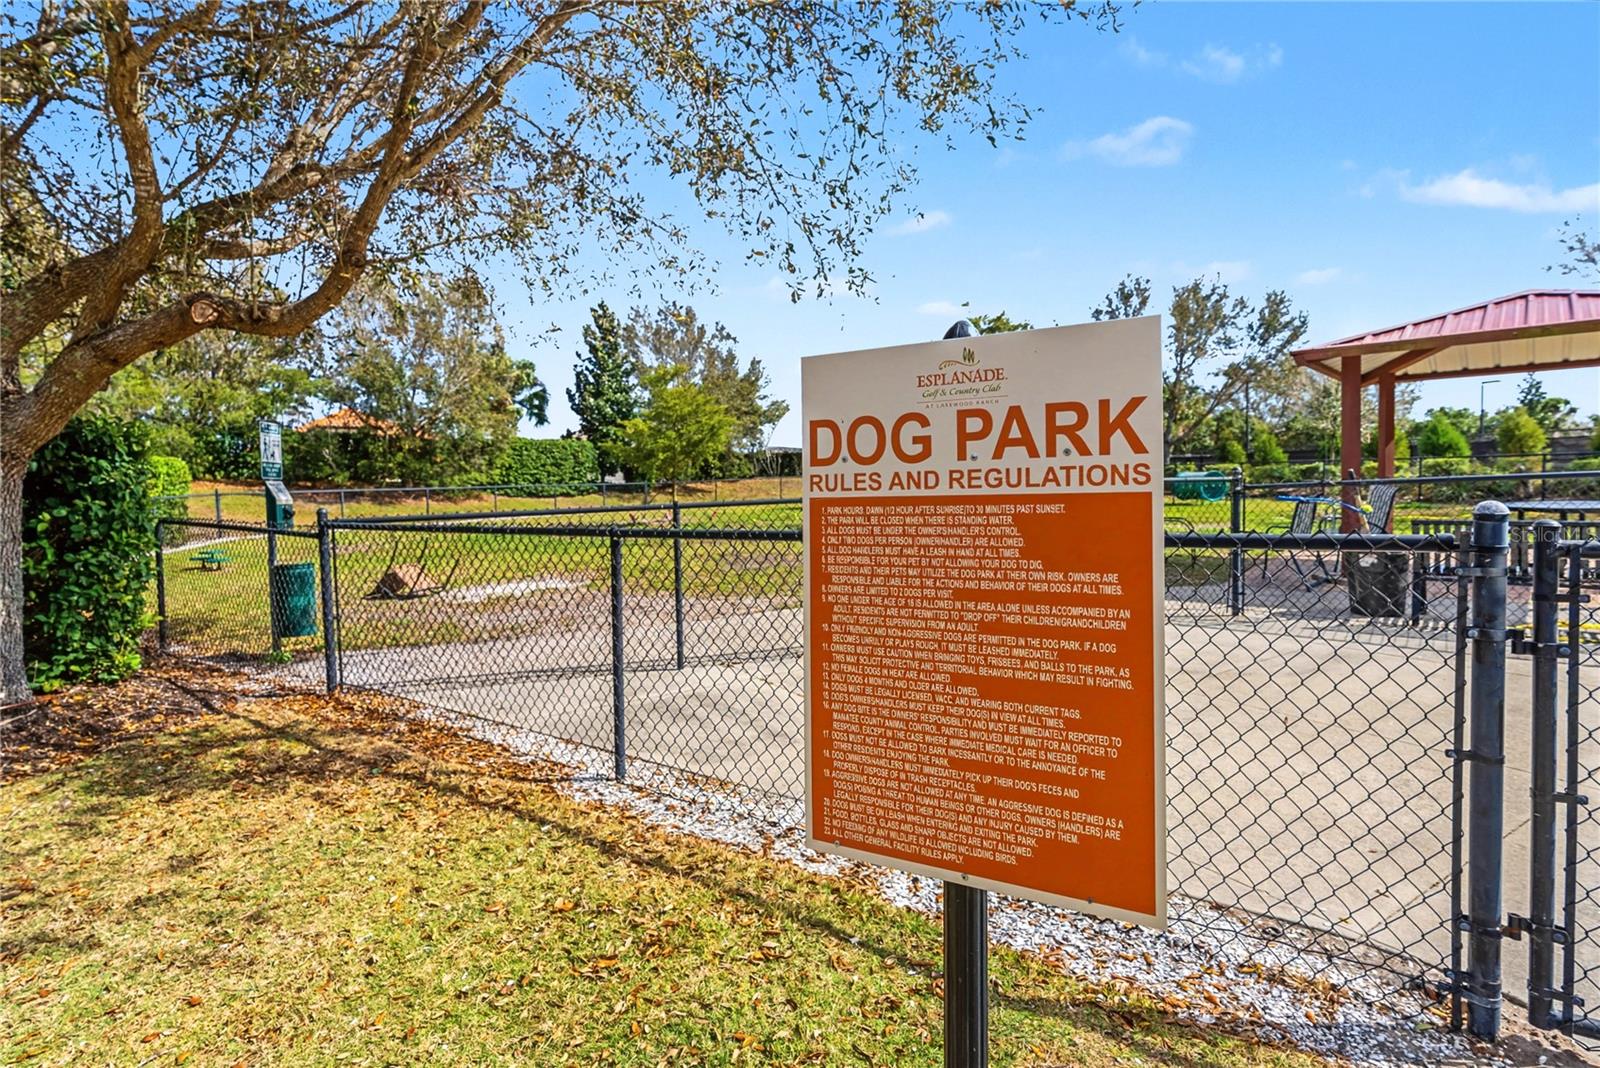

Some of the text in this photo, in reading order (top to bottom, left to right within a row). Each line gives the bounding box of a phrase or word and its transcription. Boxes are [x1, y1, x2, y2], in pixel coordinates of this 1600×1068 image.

[922, 389, 938, 399] Golf
[949, 386, 980, 396] Country
[982, 383, 1002, 393] Club
[809, 395, 1150, 468] DOG PARK
[809, 463, 1152, 492] RULES AND REGULATIONS
[914, 504, 1065, 513] AFTER MINUTES PAST SUNSET.
[904, 516, 1013, 524] WHEN THERE STANDING WATER.
[902, 547, 1020, 557] HAVE LEASH HAND ALL TIMES.
[974, 537, 1024, 546] ARE ALLOWED.
[945, 558, 1043, 569] ALLOWING YOUR DOG DIG.
[922, 568, 1117, 583] UTILIZE DOG PARK THEIR OWN OWNERS ARE
[904, 588, 921, 596] DOGS
[935, 579, 1122, 595] ACTIONS AND BEHAVIOR THEIR DOGS ALL TIMES.
[922, 599, 1105, 617] ALLOWED THE AREA ALONE UNLESS ACCOMPANIED
[1001, 614, 1022, 623] THEIR
[926, 620, 978, 631] FROM ADULT.
[943, 632, 962, 641] DOGS
[963, 633, 976, 642] ARE
[978, 634, 1016, 645] PERMITTED
[1026, 638, 1040, 647] THE
[1042, 639, 1058, 648] DOG
[1099, 643, 1115, 653] DOG
[948, 642, 1058, 660] MUST LEASHED IMMEDIATELY.
[914, 650, 1093, 674] WHEN BRINGING AND BALLS THE
[935, 662, 1131, 689] TERRITORIAL BEHAVIOR WHICH MAY RESULT FIGHTING.
[908, 680, 979, 696] OLDER ALLOWED.
[908, 701, 1064, 728] MUST KEEP THEIR VIEW ALL TIMES.
[954, 696, 1080, 718] AND WEARING BOTH CURRENT TAGS.
[940, 726, 1105, 756] PARTIES INVOLVED MUST WAIT FOR OFFICER
[972, 719, 1109, 745] AND MUST IMMEDIATELY REPORTED
[906, 731, 1078, 764] CASE WHERE IMMEDIATE MEDICAL CARE NEEDED.
[928, 745, 1104, 779] BARK INCESSANTLY THE ANNOYANCE THE
[904, 762, 1078, 798] MUST PICK THEIR FECES AND
[907, 772, 927, 783] TRASH
[913, 784, 1104, 825] ALLOWED ANY AGGRESSIVE DOG DEFINED
[915, 804, 1078, 843] THEIR AND ANY INJURY CAUSED THEM.
[916, 794, 1119, 840] HUMAN BEINGS OTHER OWNERS ARE
[906, 813, 1036, 846] WHEN ENTERING AND EXITING THE PARK.
[914, 825, 1032, 857] SHARP OBJECTS ARE NOT ALLOWED.
[925, 837, 1016, 864] ALLOWED INCLUDING BIRDS.
[920, 847, 941, 859] RULES
